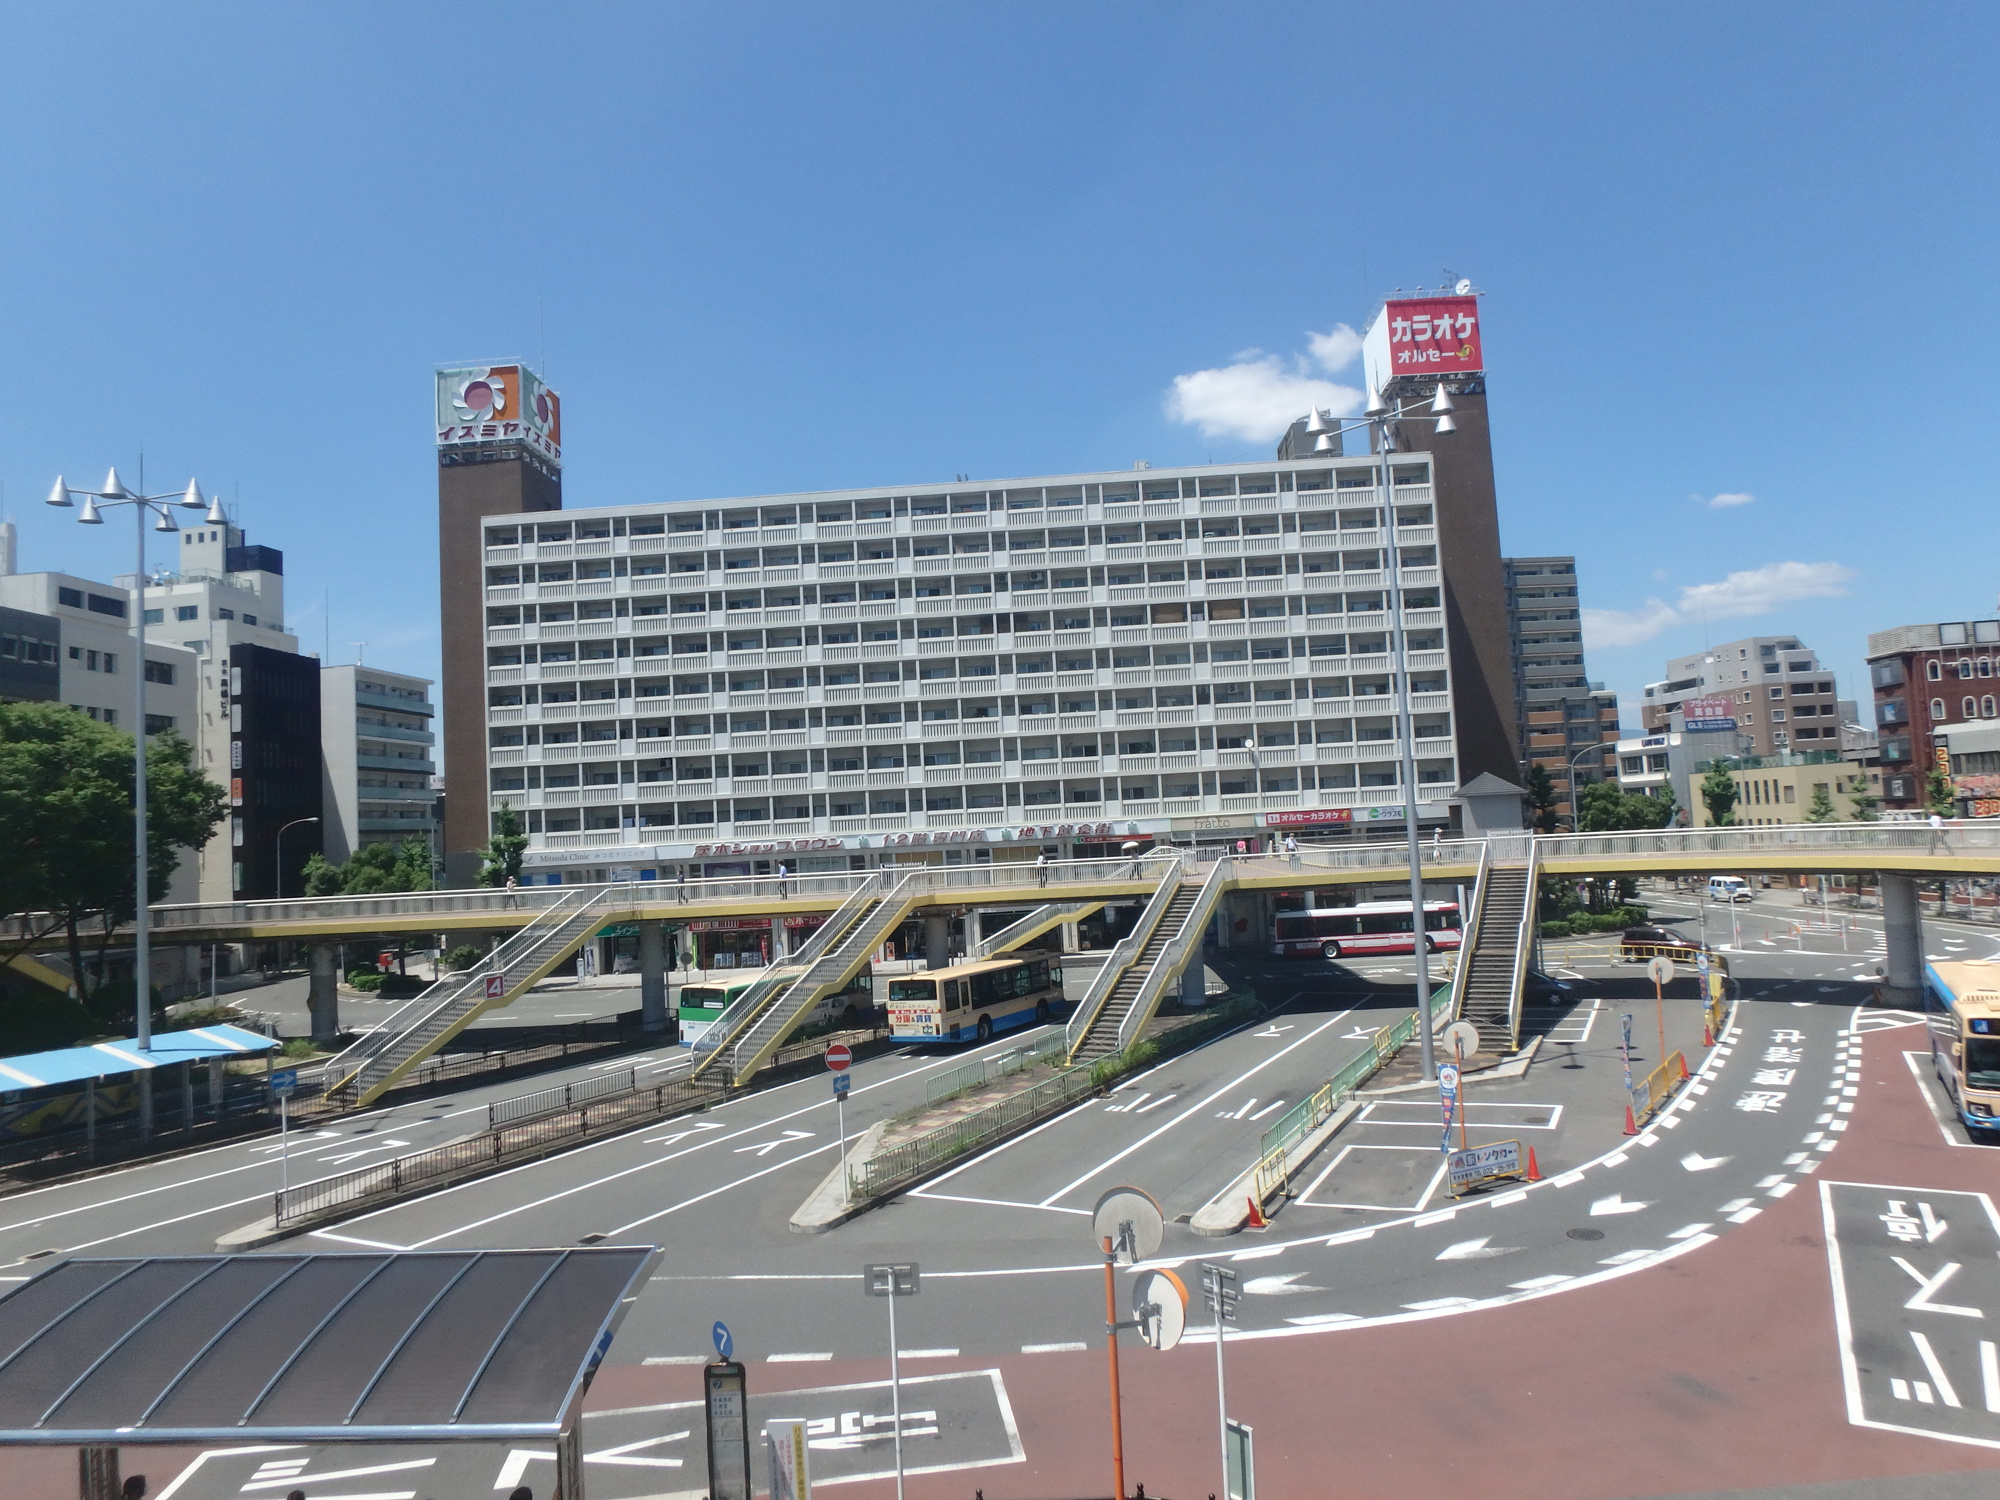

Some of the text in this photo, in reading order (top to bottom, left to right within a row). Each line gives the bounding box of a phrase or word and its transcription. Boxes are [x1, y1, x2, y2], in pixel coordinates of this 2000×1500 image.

[1391, 312, 1476, 343] カラオケ
[1397, 348, 1455, 364] オルセー
[438, 422, 519, 441] イズミヤ
[1687, 721, 1703, 729] GLS
[1194, 816, 1230, 829] fratto
[1281, 812, 1339, 822] オルセーカラオケ
[1381, 810, 1403, 819] クラスモ
[693, 838, 844, 857] 茨木ショップタウン
[1017, 822, 1113, 838] 地下飲食街
[539, 850, 645, 863] Mitsuda Clinic みつだクリニック
[487, 977, 502, 995] 4
[716, 1327, 728, 1351] 7
